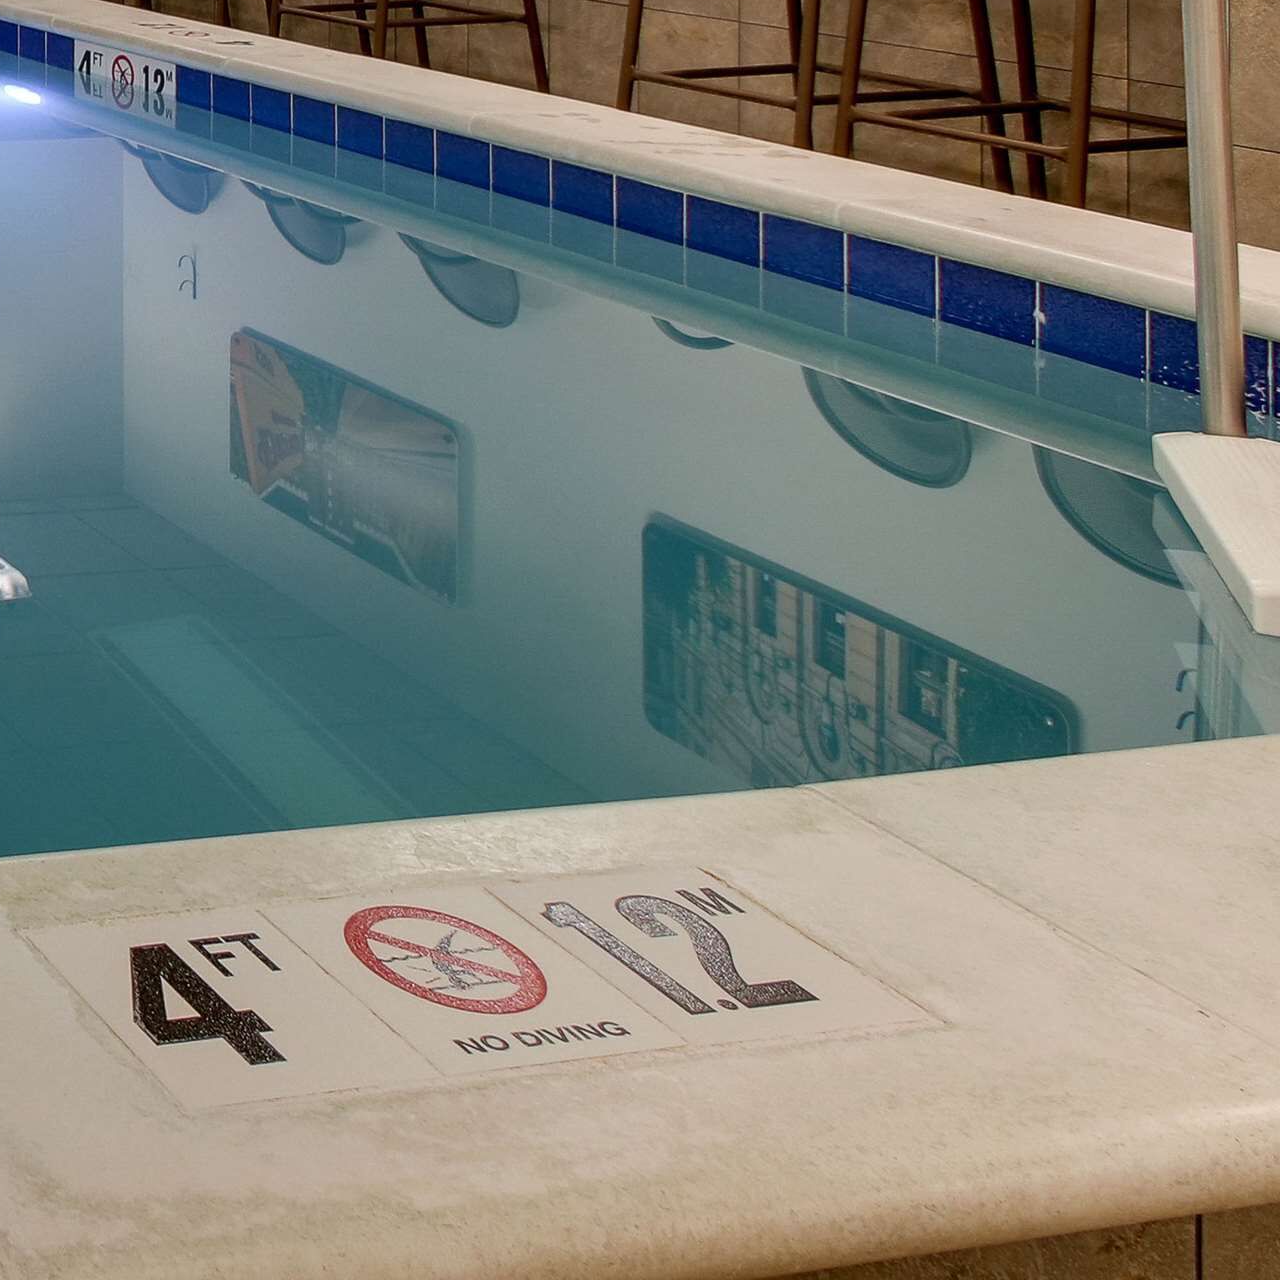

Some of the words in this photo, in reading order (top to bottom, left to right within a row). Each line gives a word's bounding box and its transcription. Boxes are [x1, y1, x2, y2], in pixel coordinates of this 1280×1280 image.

[93, 52, 103, 67] FT
[166, 70, 173, 81] M
[677, 886, 747, 919] M
[188, 931, 283, 977] FT
[128, 942, 287, 1067] 4
[453, 1034, 510, 1055] NO
[511, 1021, 631, 1048] DIVING
